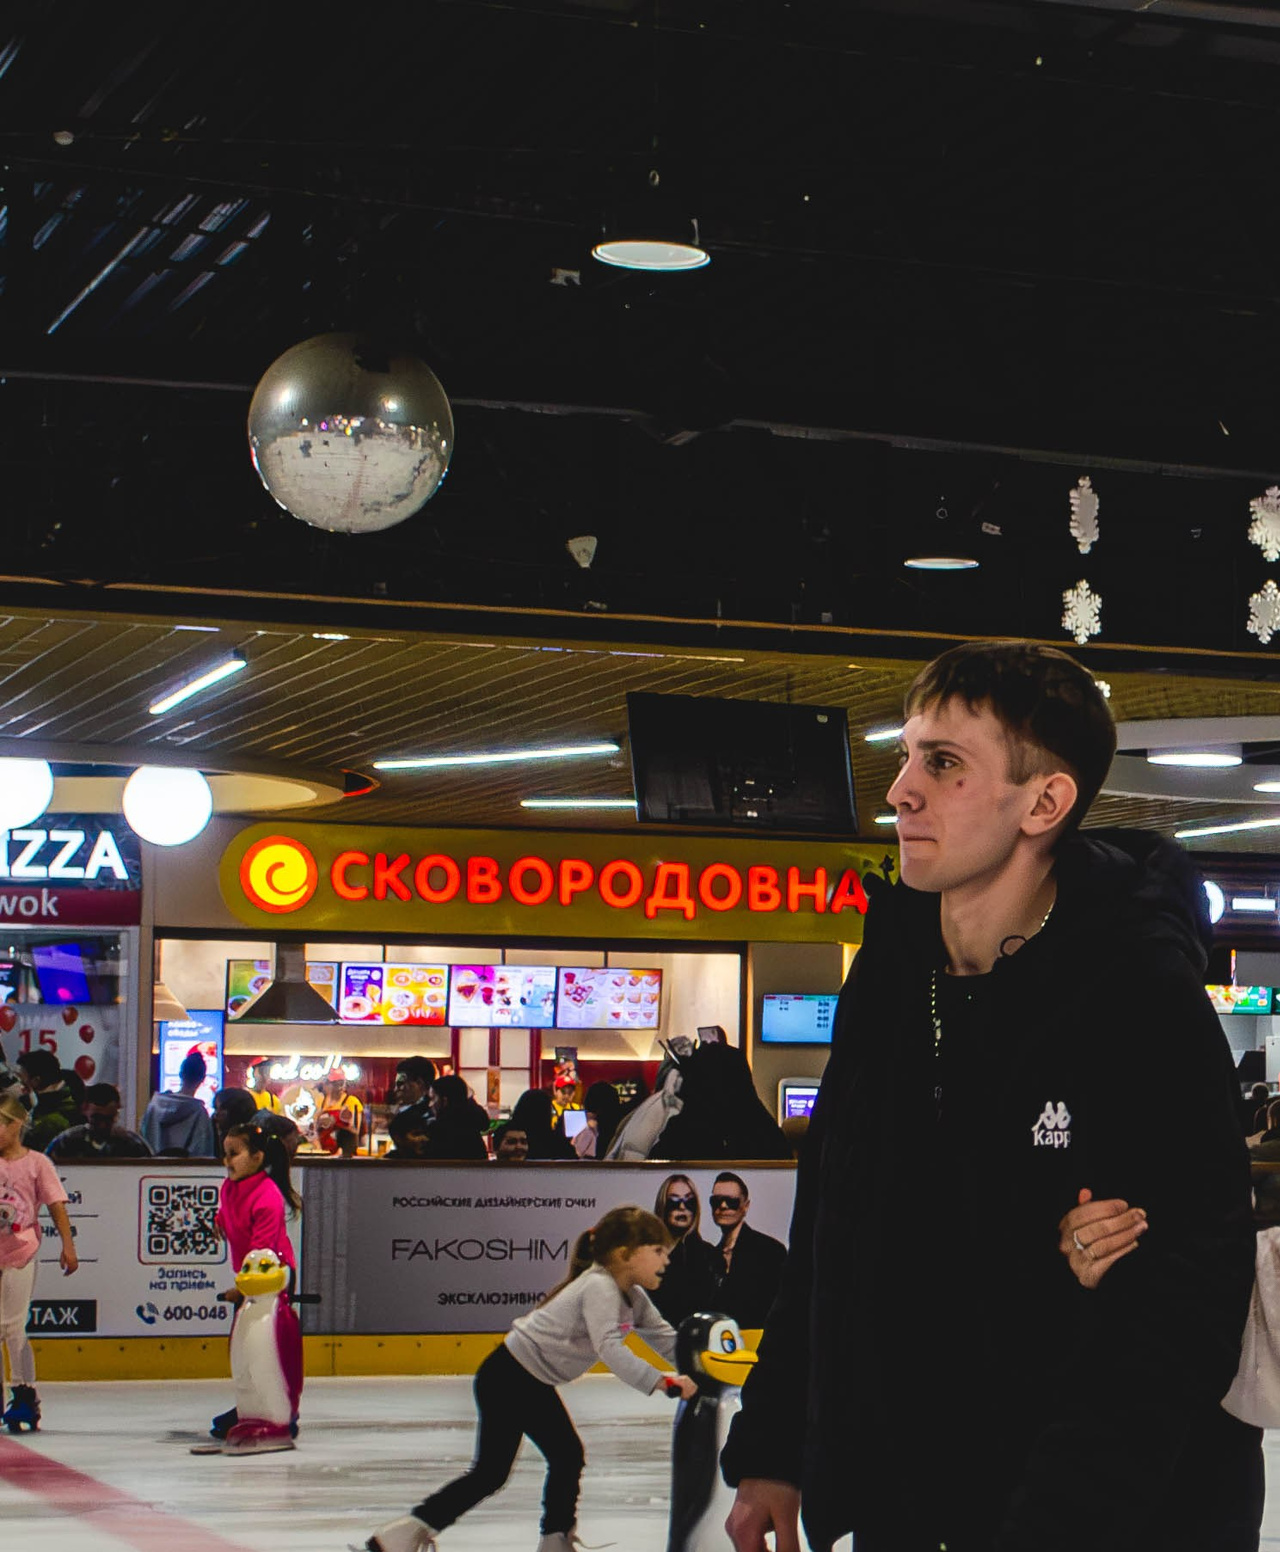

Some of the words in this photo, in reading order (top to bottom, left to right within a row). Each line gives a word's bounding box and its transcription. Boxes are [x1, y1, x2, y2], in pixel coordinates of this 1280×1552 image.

[330, 851, 869, 921] СКОВОРОДОВНА
[18, 1028, 57, 1056] 15
[392, 1195, 472, 1208] РОССИЙСКИЕ
[474, 1195, 561, 1208] ДИЗАЙНЕРСКИЕ
[565, 1198, 596, 1208] ОЧКИ
[158, 1267, 207, 1280] Запись
[149, 1281, 167, 1290] на
[437, 1292, 548, 1306] ЭКСКЛЮЗИВНО
[163, 1305, 228, 1321] 600-048
